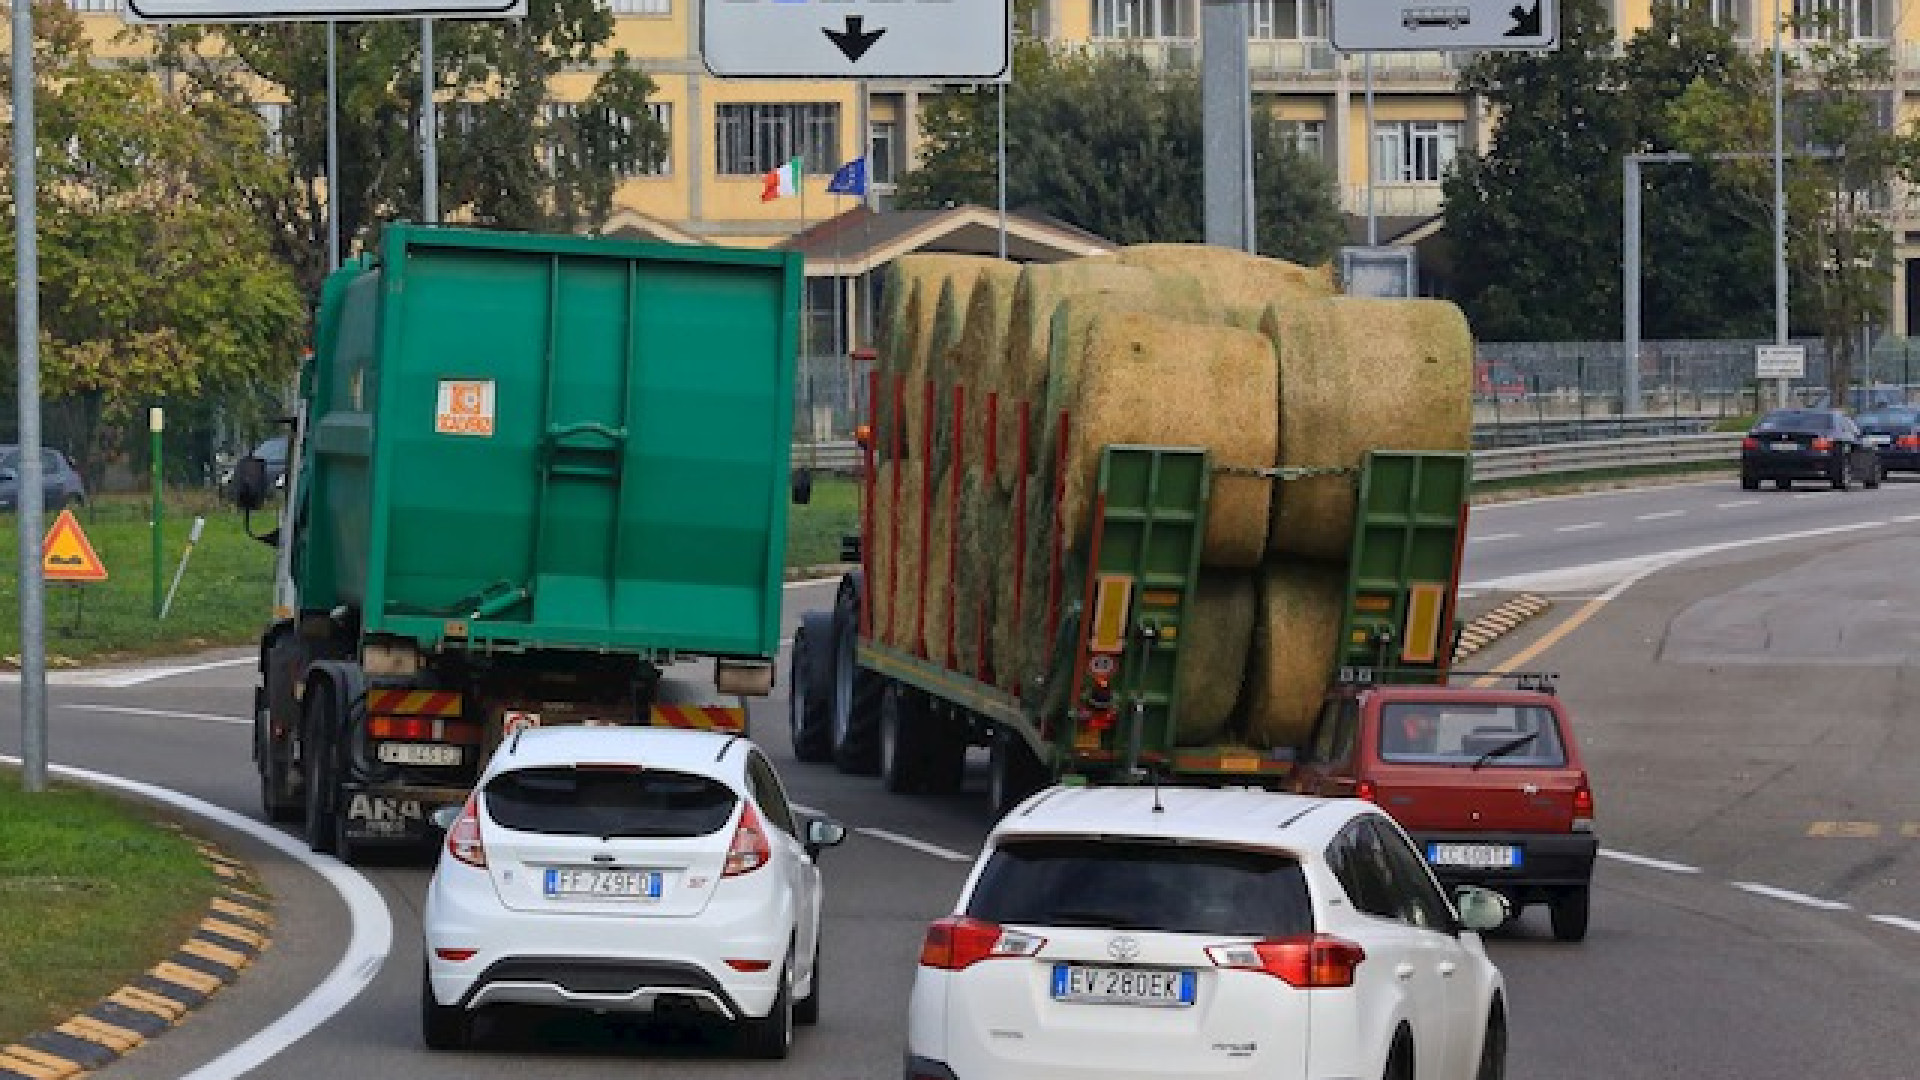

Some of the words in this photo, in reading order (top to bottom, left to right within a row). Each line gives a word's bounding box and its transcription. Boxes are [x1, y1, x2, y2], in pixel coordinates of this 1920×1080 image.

[560, 872, 582, 891] FF
[1070, 969, 1099, 994] EV
[1106, 971, 1177, 998] 280EK
